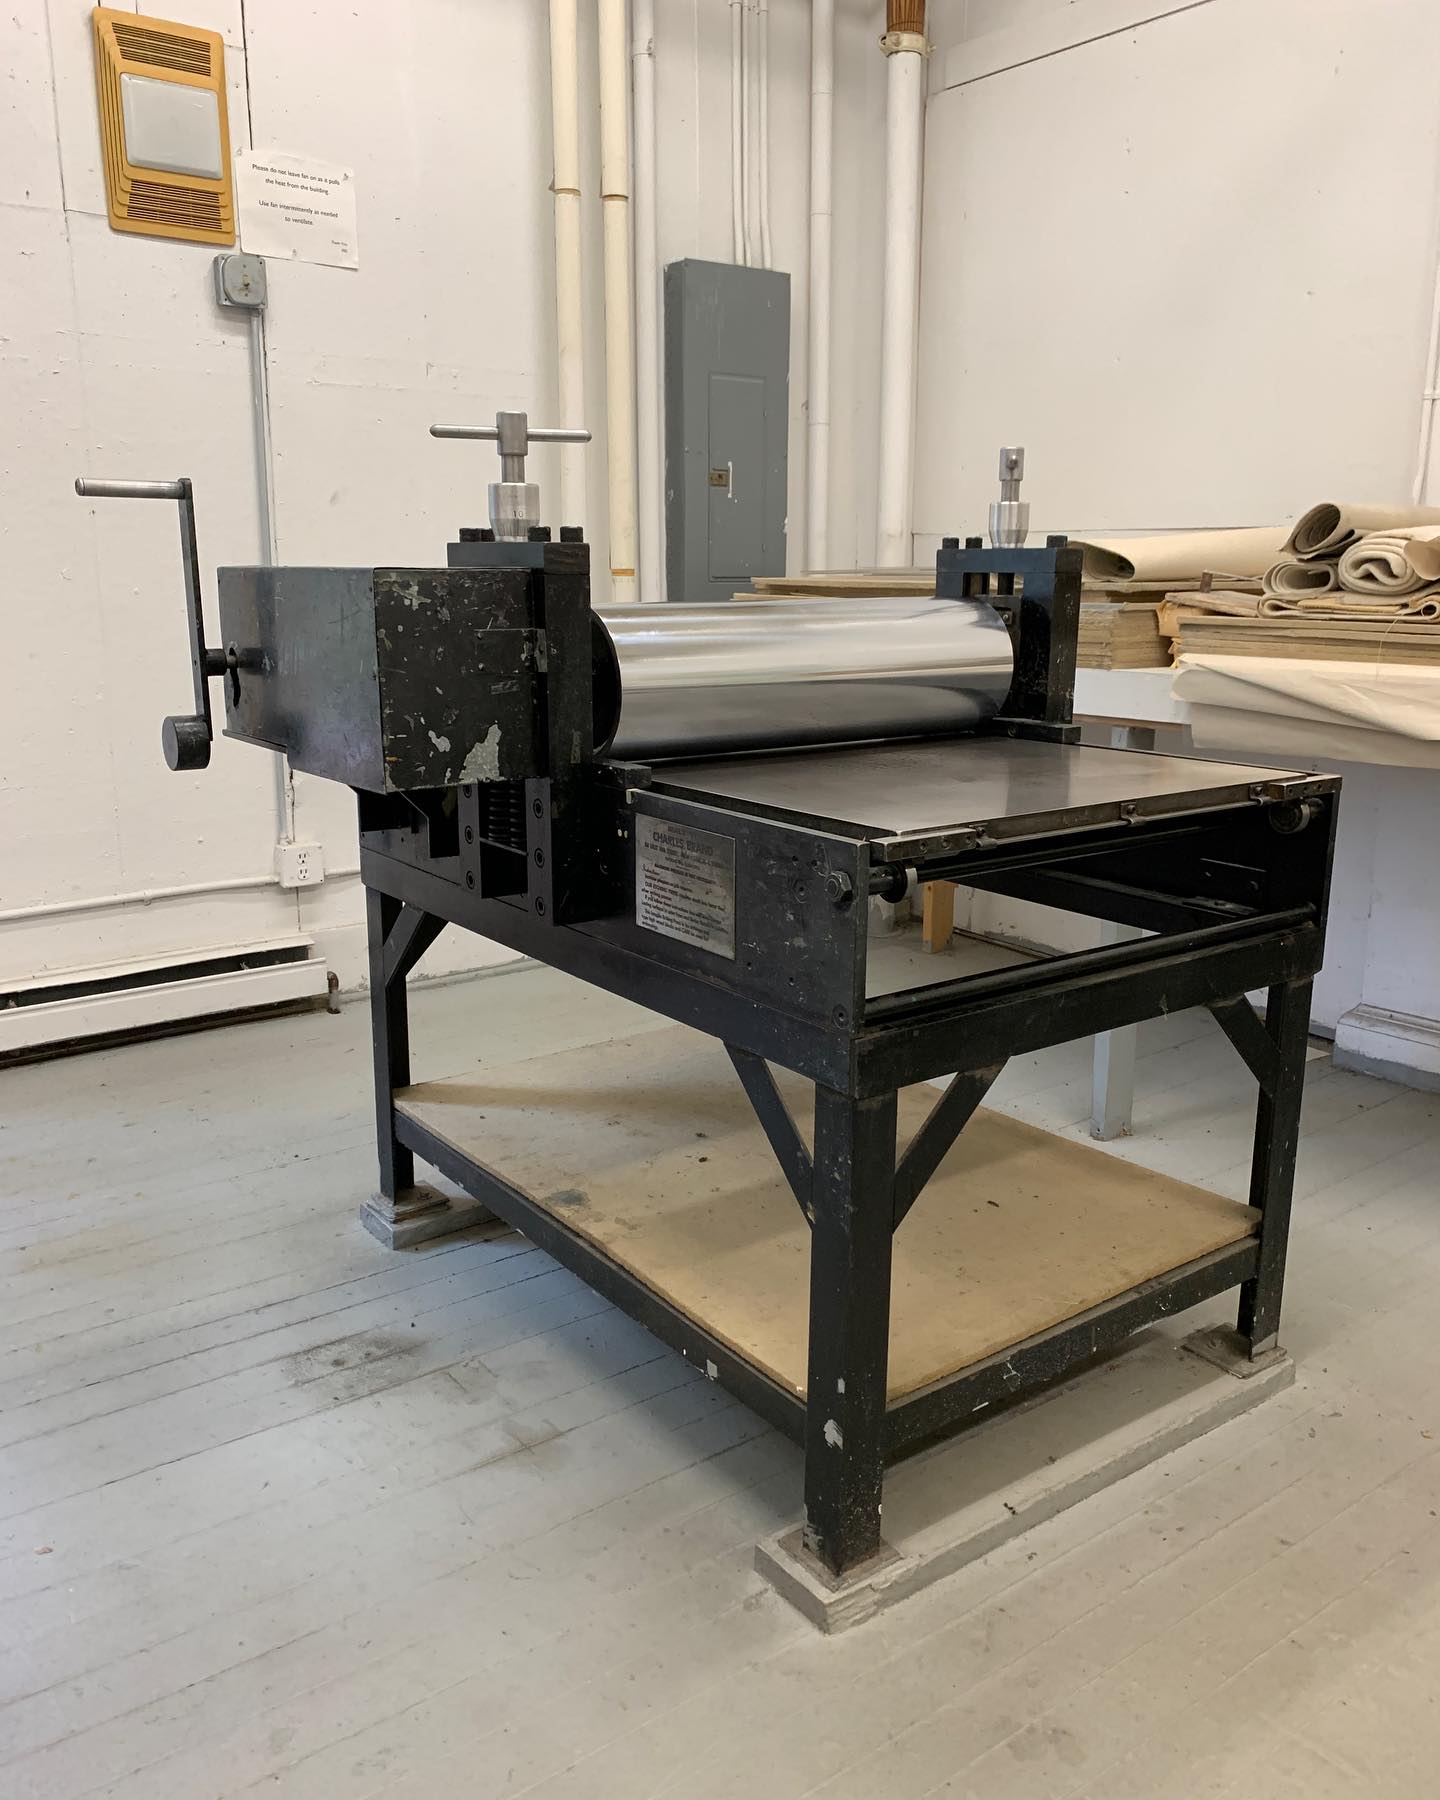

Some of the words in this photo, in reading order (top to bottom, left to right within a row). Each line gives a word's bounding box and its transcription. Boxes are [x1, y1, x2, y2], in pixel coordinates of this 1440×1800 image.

[252, 164, 268, 172] Please
[275, 179, 286, 187] heat
[652, 832, 684, 849] CHARLES
